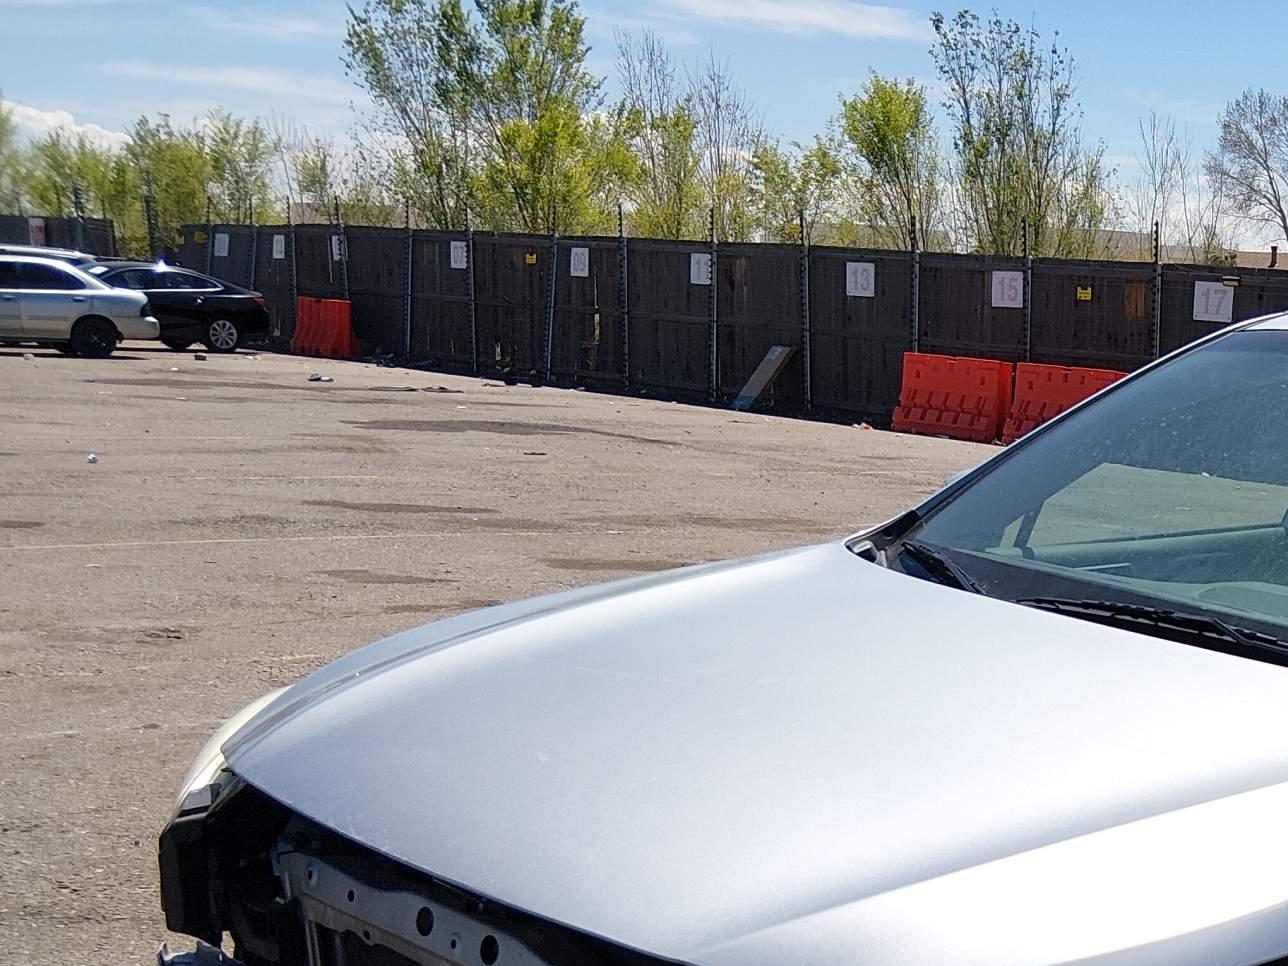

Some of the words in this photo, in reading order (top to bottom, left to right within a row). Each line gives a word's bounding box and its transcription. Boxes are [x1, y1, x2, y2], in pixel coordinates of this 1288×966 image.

[850, 266, 871, 293] 13
[1000, 274, 1019, 302] 15
[1201, 287, 1228, 318] 17
